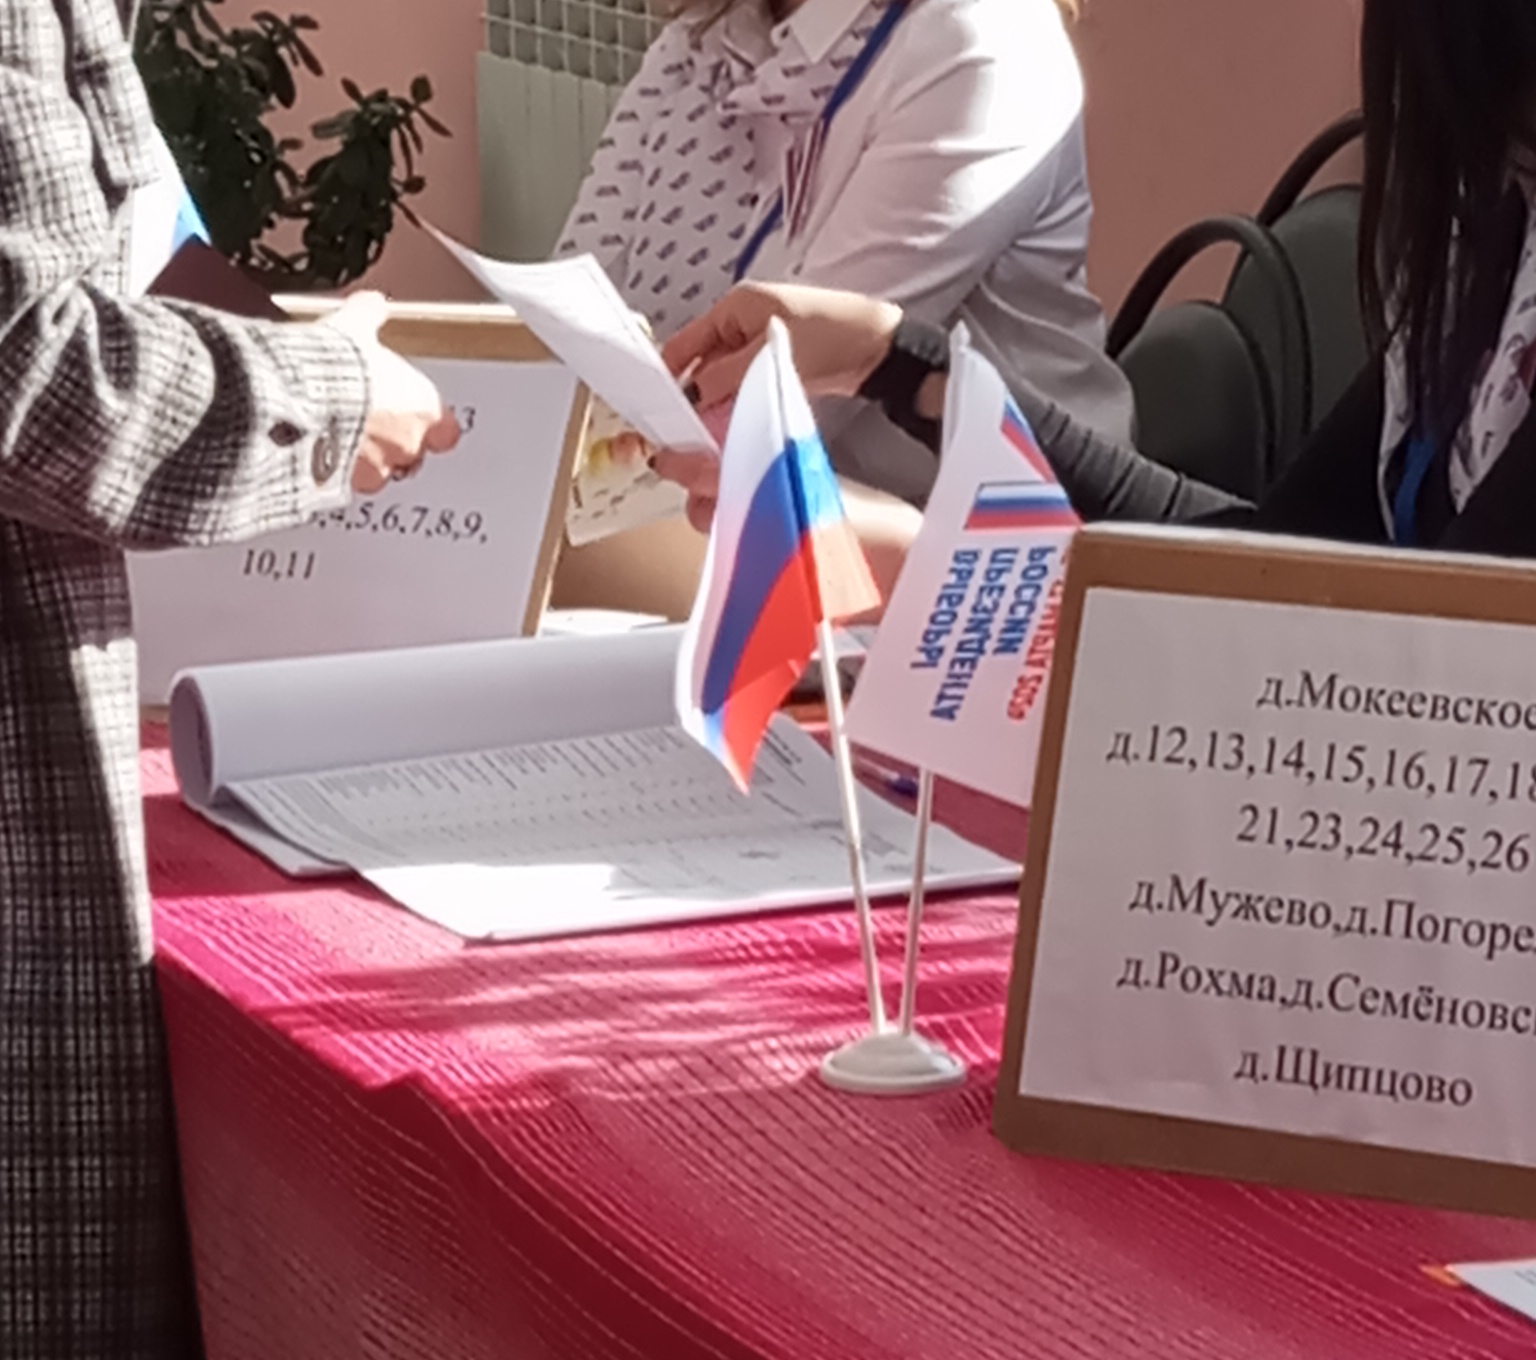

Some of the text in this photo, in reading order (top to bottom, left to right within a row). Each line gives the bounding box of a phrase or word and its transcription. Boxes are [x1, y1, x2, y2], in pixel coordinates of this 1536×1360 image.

[244, 548, 315, 581] 10,11
[1236, 803, 1531, 875] 21,23,24,25,26
[1128, 873, 1536, 961] д.Мужево,д.Погоре
[1116, 951, 1536, 1035] д.Рохма,д.Семёновс
[1233, 1044, 1473, 1107] д.Щипцово
